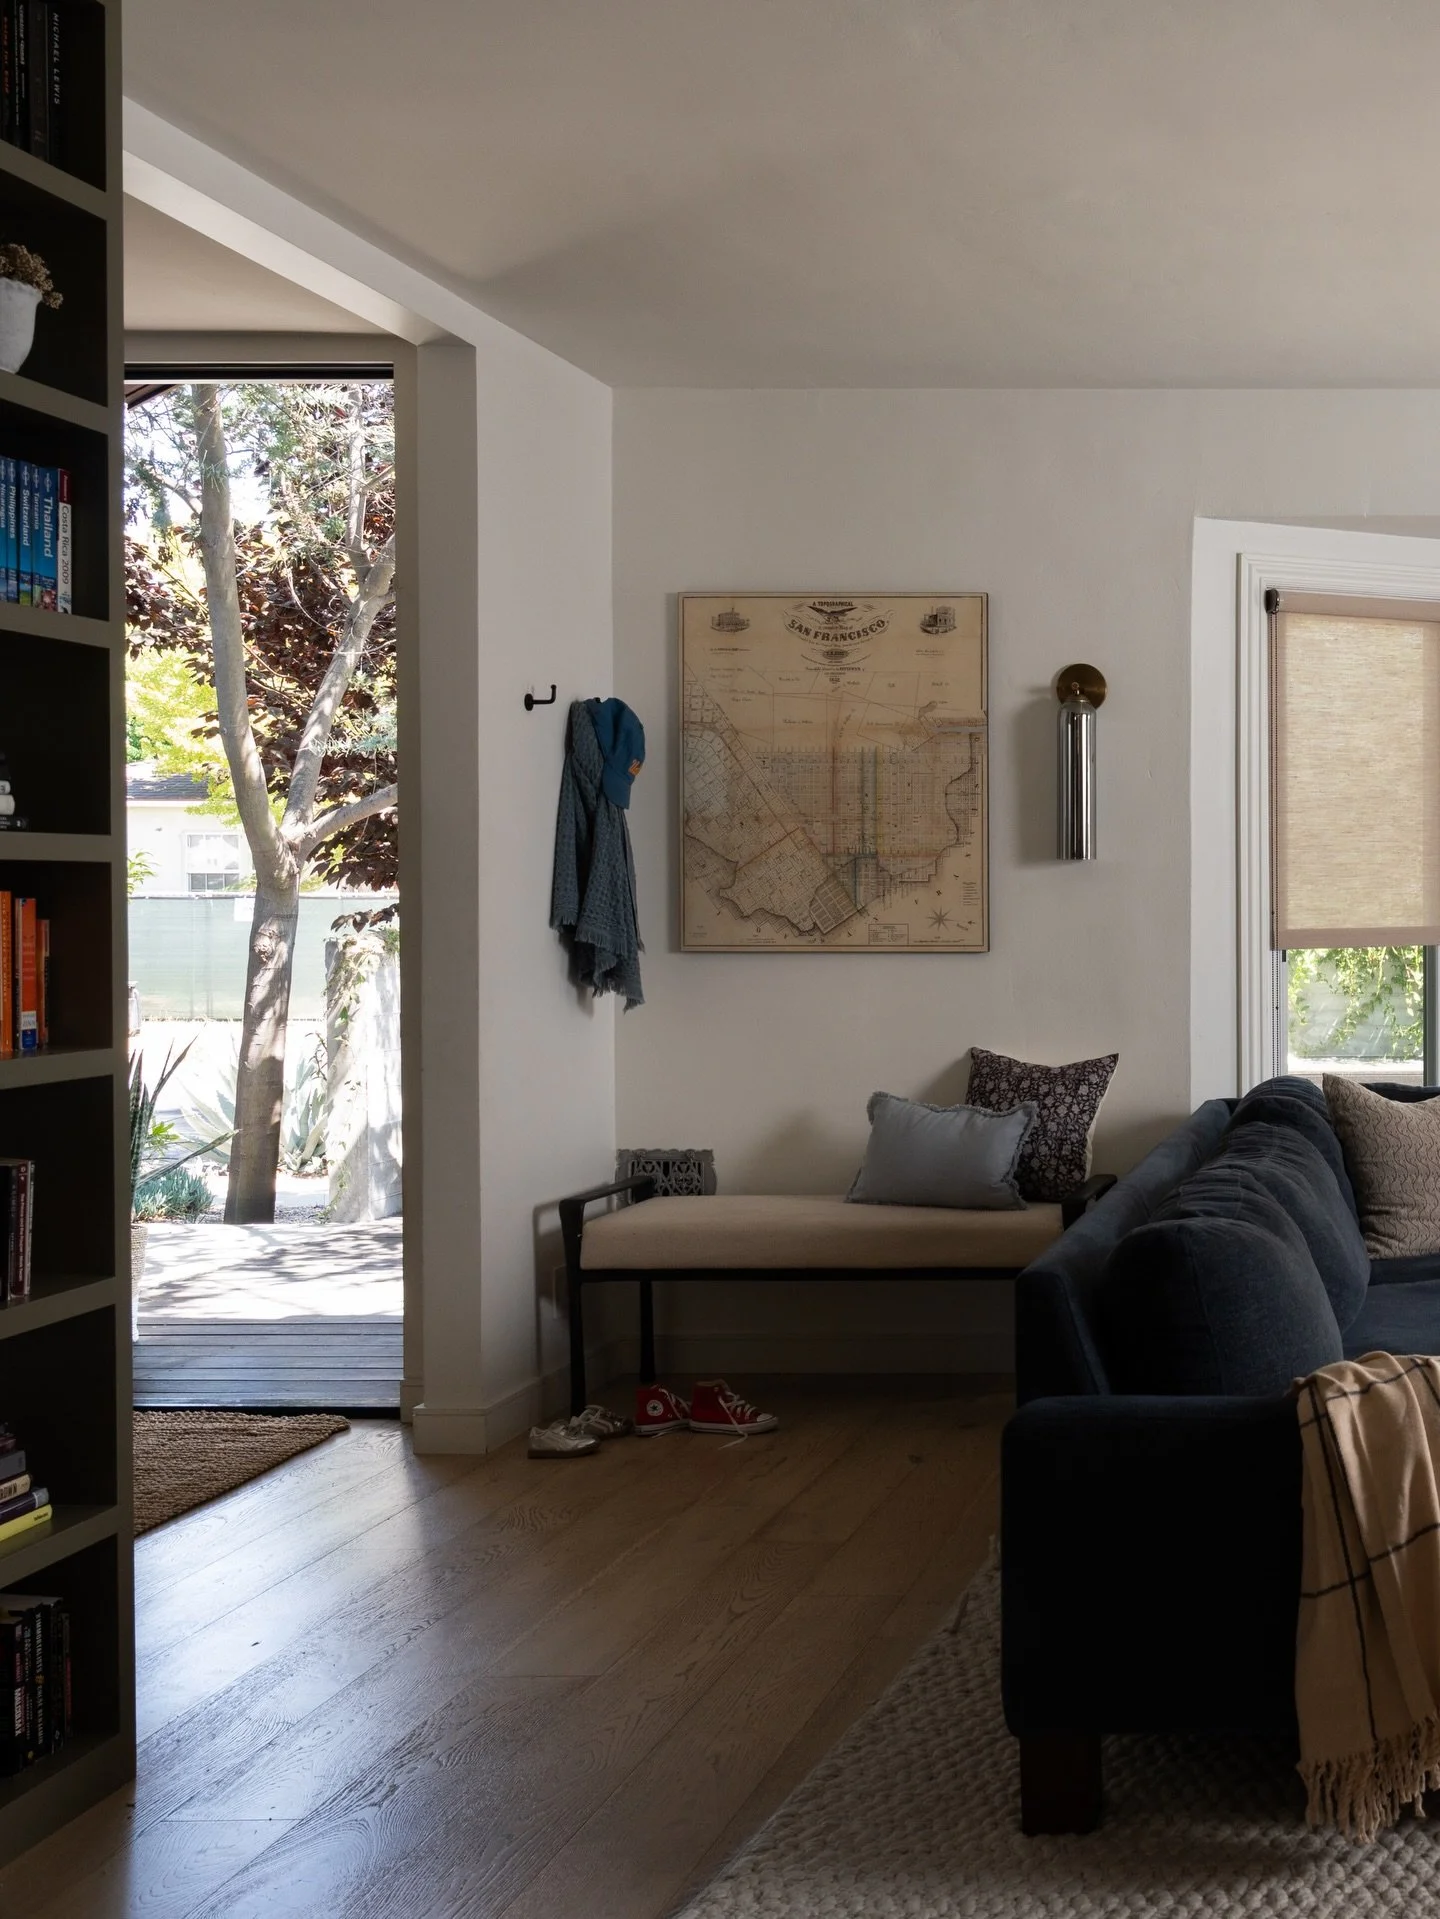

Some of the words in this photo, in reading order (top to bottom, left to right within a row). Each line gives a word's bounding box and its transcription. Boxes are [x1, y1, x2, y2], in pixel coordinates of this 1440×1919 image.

[52, 11, 61, 64] MICHAEL
[53, 67, 61, 105] LEWIS
[8, 485, 17, 539] Philippines
[22, 488, 30, 547] Switzerland
[43, 496, 54, 558] Thailand
[61, 505, 69, 534] Costa
[787, 619, 812, 636] SAN
